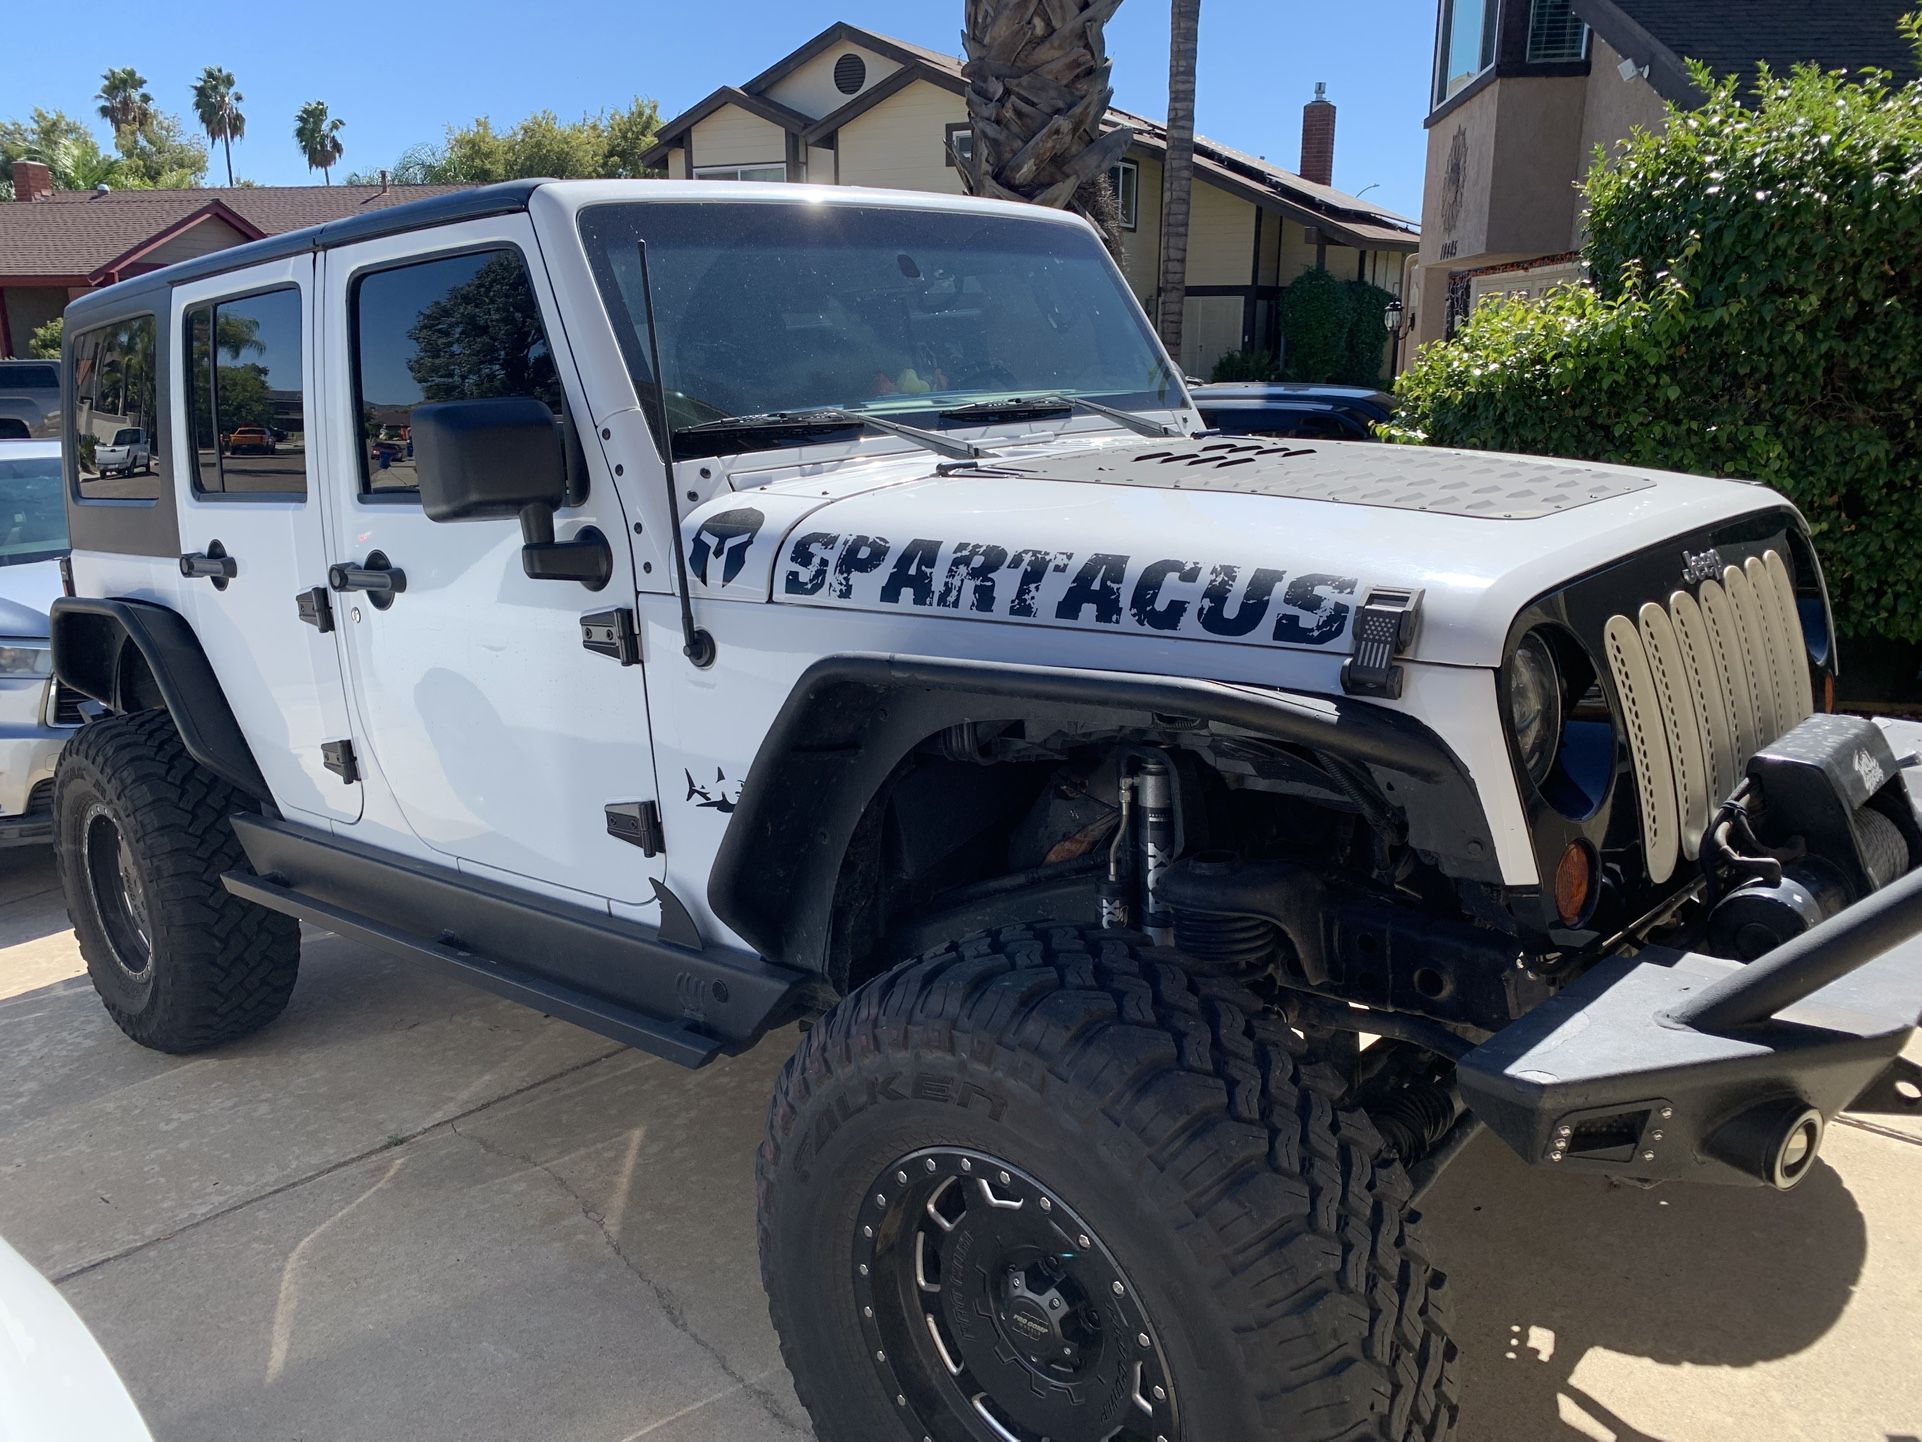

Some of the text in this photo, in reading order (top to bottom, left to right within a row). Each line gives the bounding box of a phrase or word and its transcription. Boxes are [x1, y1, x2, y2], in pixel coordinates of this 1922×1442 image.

[1682, 548, 1722, 585] Jeep
[784, 531, 1358, 646] SPARTACUS
[1013, 1314, 1049, 1333] PRO COMP
